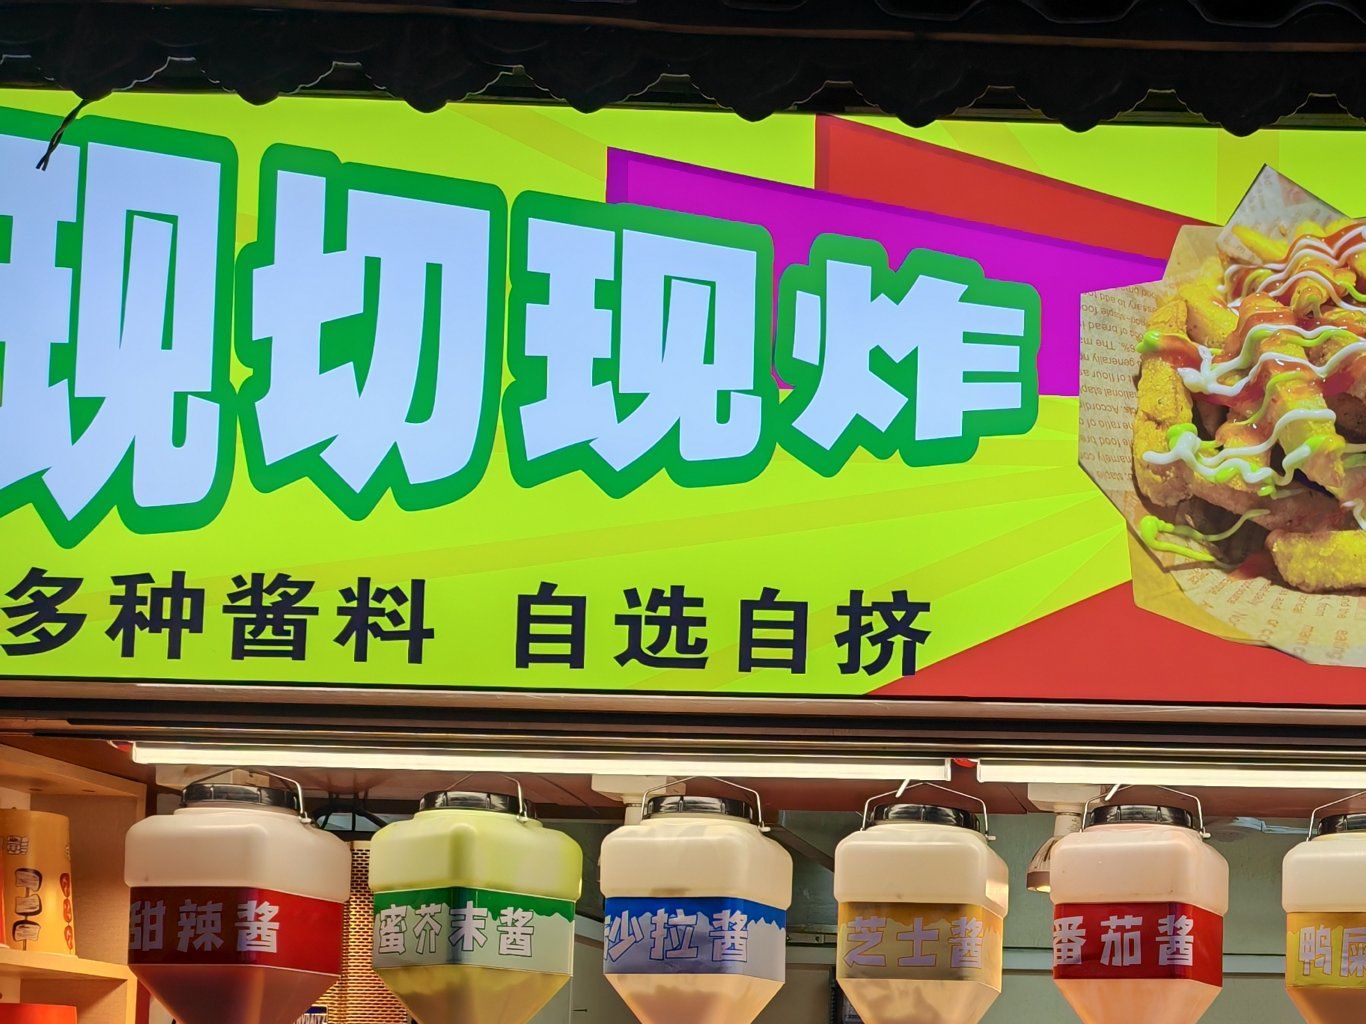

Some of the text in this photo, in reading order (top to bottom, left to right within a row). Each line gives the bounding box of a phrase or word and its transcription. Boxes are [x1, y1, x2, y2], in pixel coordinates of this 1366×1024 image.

[0, 138, 1028, 524] 现切现炸
[3, 566, 932, 677] 多种酱料 自选自挤
[130, 898, 280, 954] 甜辣酱
[378, 899, 535, 958] 蜜芥末酱
[844, 915, 984, 970] 芝士酱
[1053, 913, 1195, 968] 番茄酱
